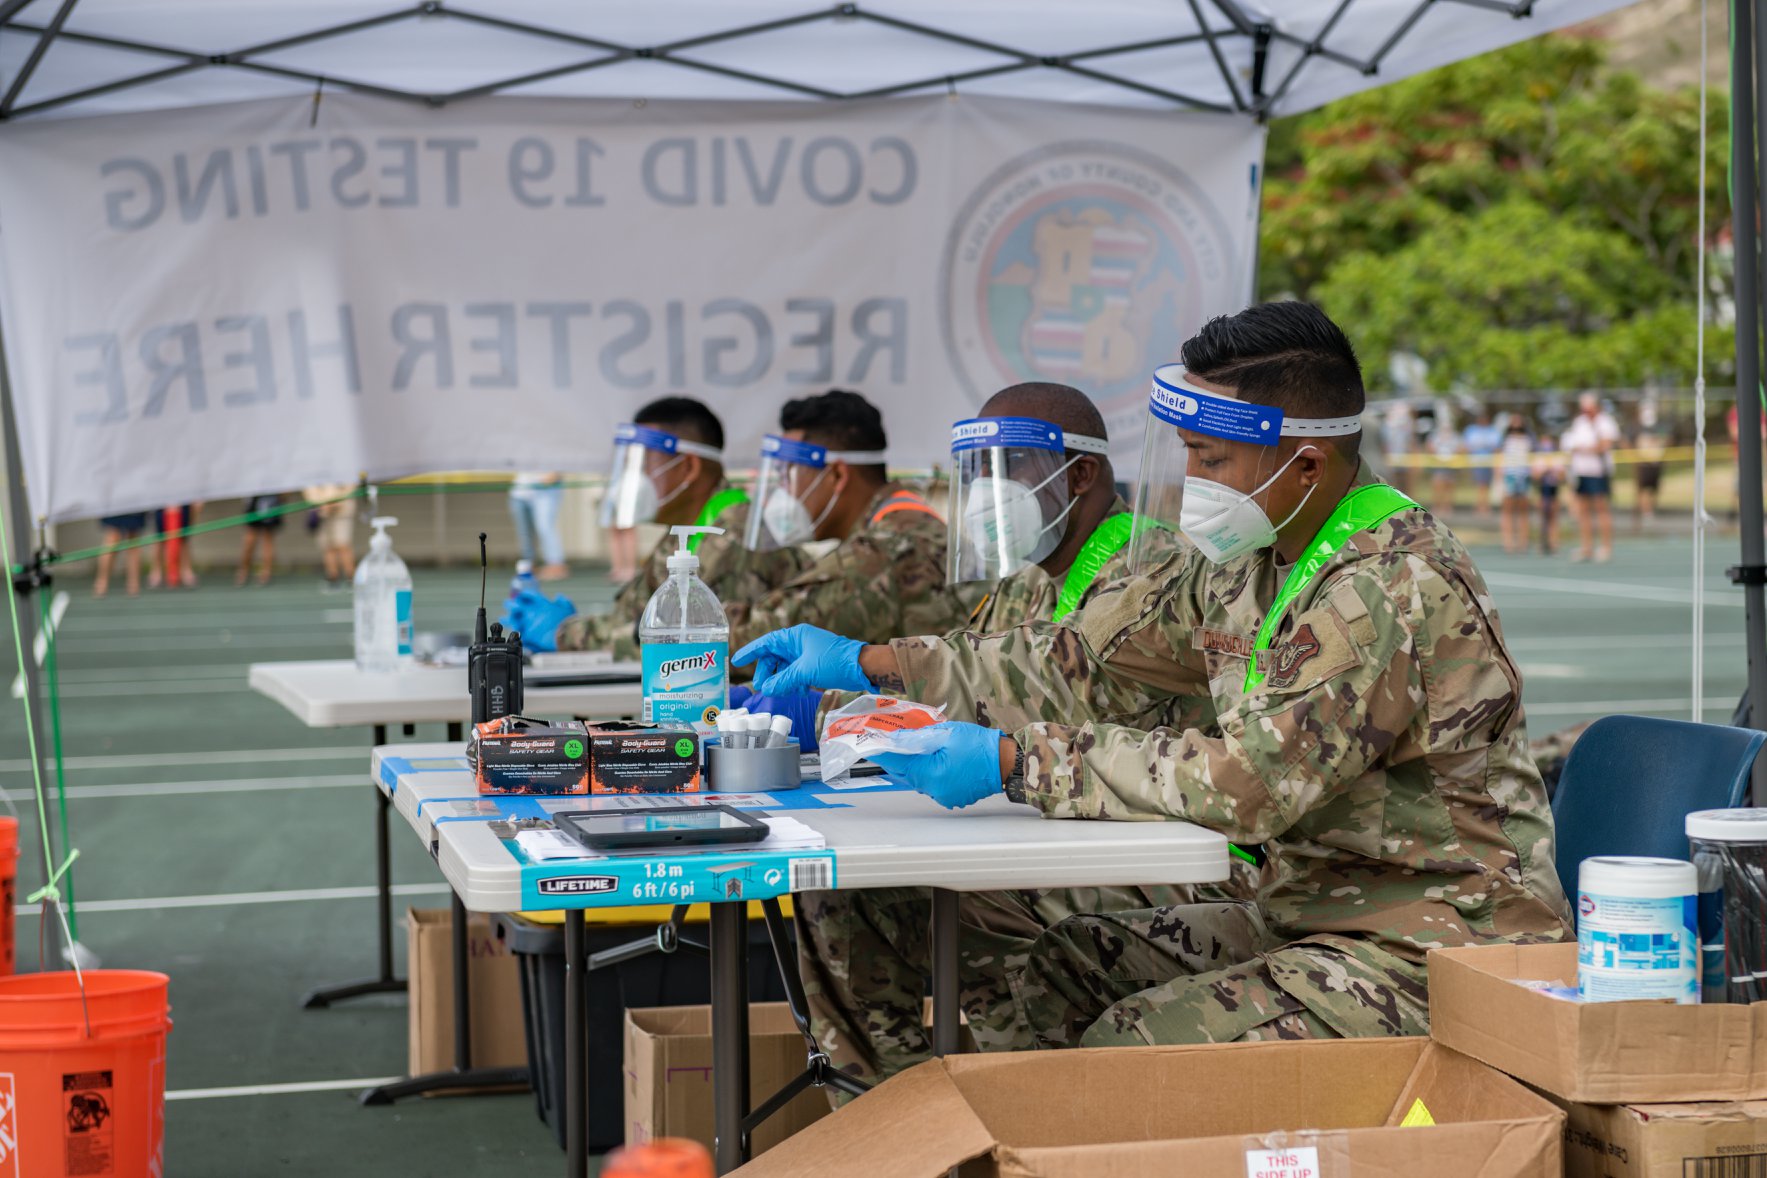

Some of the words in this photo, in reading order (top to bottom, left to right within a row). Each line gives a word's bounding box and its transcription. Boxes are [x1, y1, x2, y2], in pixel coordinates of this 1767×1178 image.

[1157, 389, 1186, 410] Shield
[960, 425, 988, 436] Shield
[660, 650, 717, 679] germ-X
[659, 691, 704, 699] moisturizing
[660, 702, 692, 711] original
[644, 863, 666, 878] 1.8
[669, 865, 682, 877] m
[547, 879, 609, 891] LIFETIME
[633, 884, 642, 898] 6
[644, 882, 657, 898] ft
[669, 882, 678, 896] 6
[681, 881, 695, 899] pi
[1267, 1155, 1298, 1167] THIS
[1256, 1170, 1287, 1178] SIDE
[1293, 1169, 1312, 1178] UP
